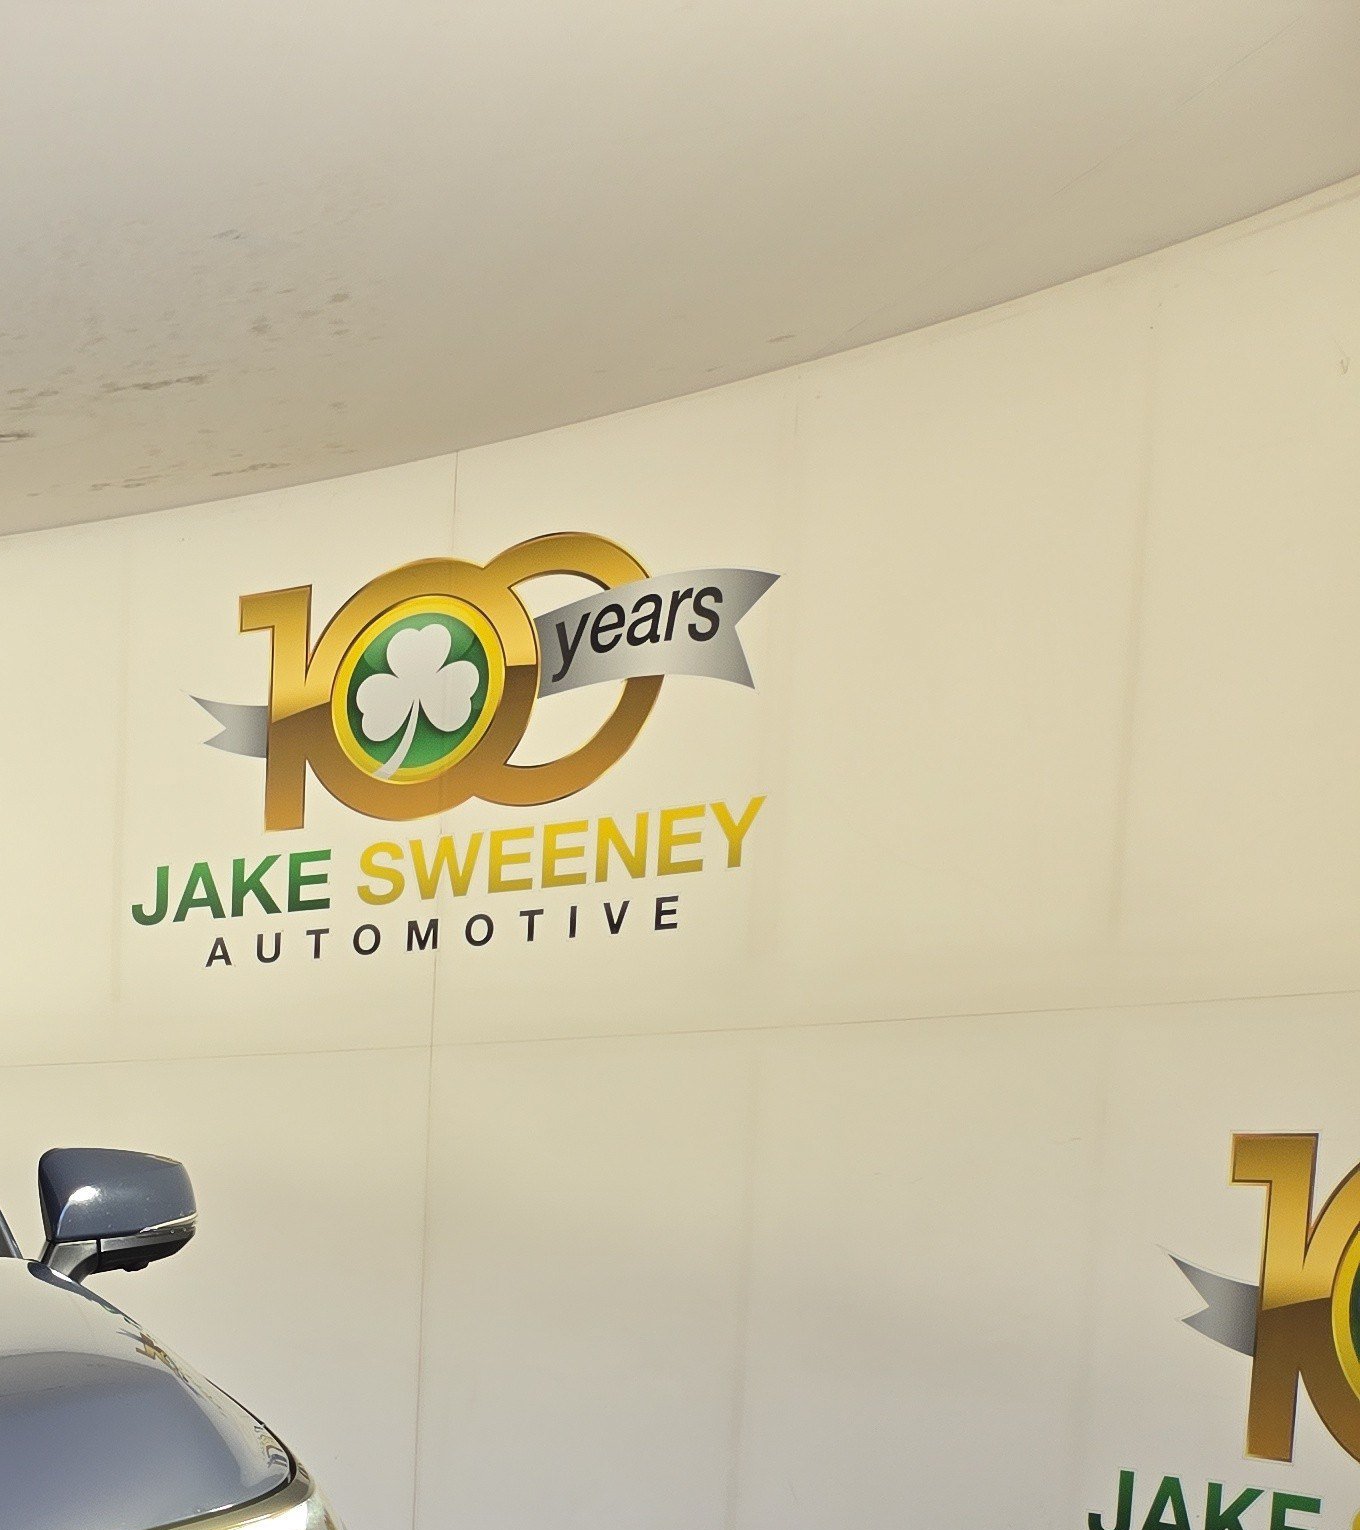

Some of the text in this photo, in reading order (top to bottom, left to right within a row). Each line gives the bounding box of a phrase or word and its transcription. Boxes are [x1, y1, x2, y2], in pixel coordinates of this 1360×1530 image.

[552, 583, 724, 682] years
[131, 795, 768, 926] JAKE SWEENEY
[205, 895, 679, 968] AUTOMOTIVE
